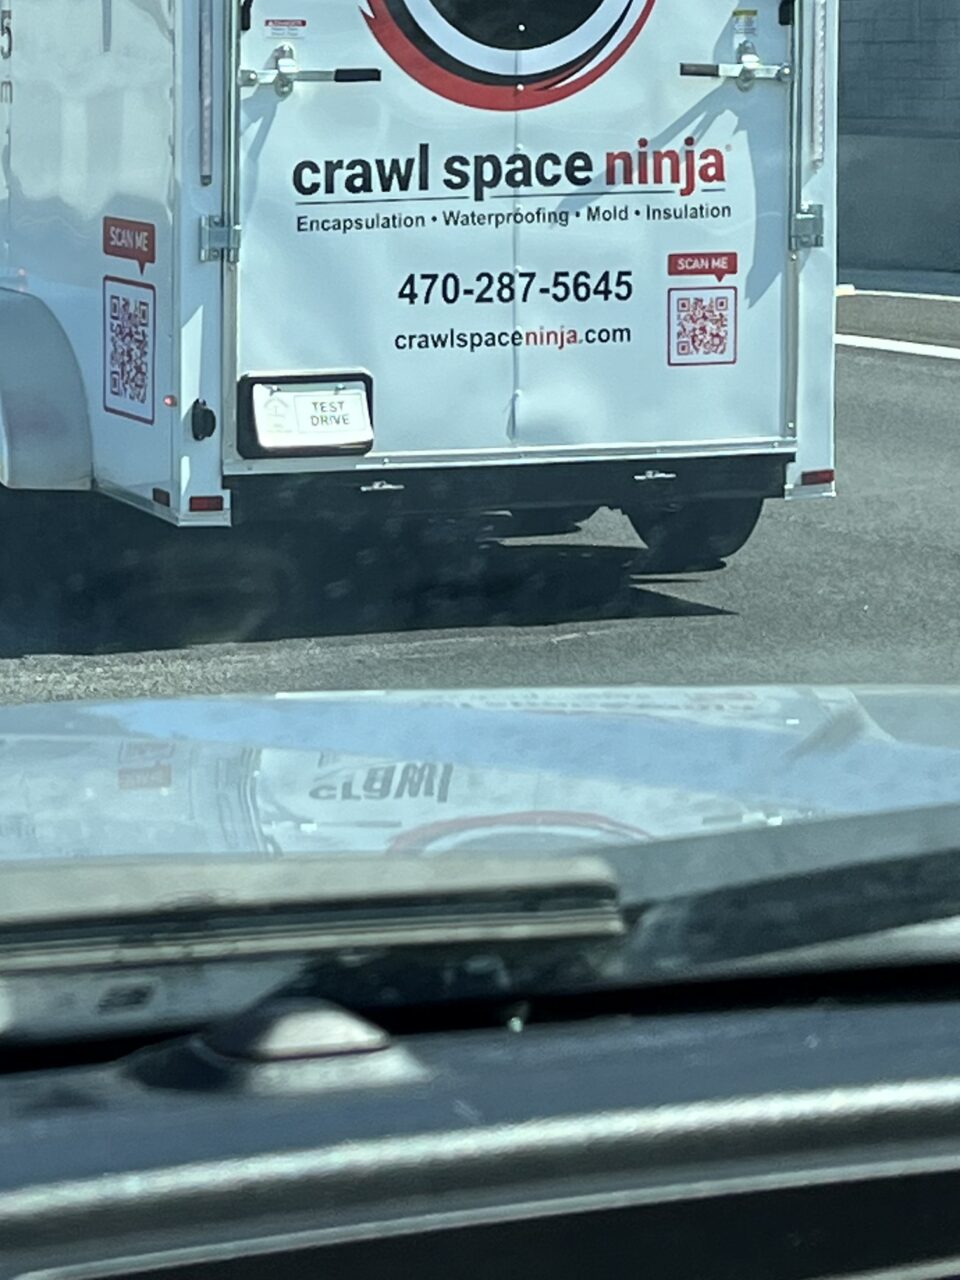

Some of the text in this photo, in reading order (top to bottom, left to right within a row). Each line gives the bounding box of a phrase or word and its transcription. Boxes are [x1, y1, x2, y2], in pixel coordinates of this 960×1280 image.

[292, 136, 727, 202] crawl space ninja
[296, 202, 732, 234] Encapsulation Waterproofing Mold Insulation
[109, 225, 149, 252] SCAN ME
[676, 256, 729, 270] SCAN ME
[397, 270, 634, 305] 470-287-5645
[394, 326, 632, 353] crawlspaceninja.com
[310, 414, 350, 426] DRIVE
[311, 401, 345, 413] TEST
